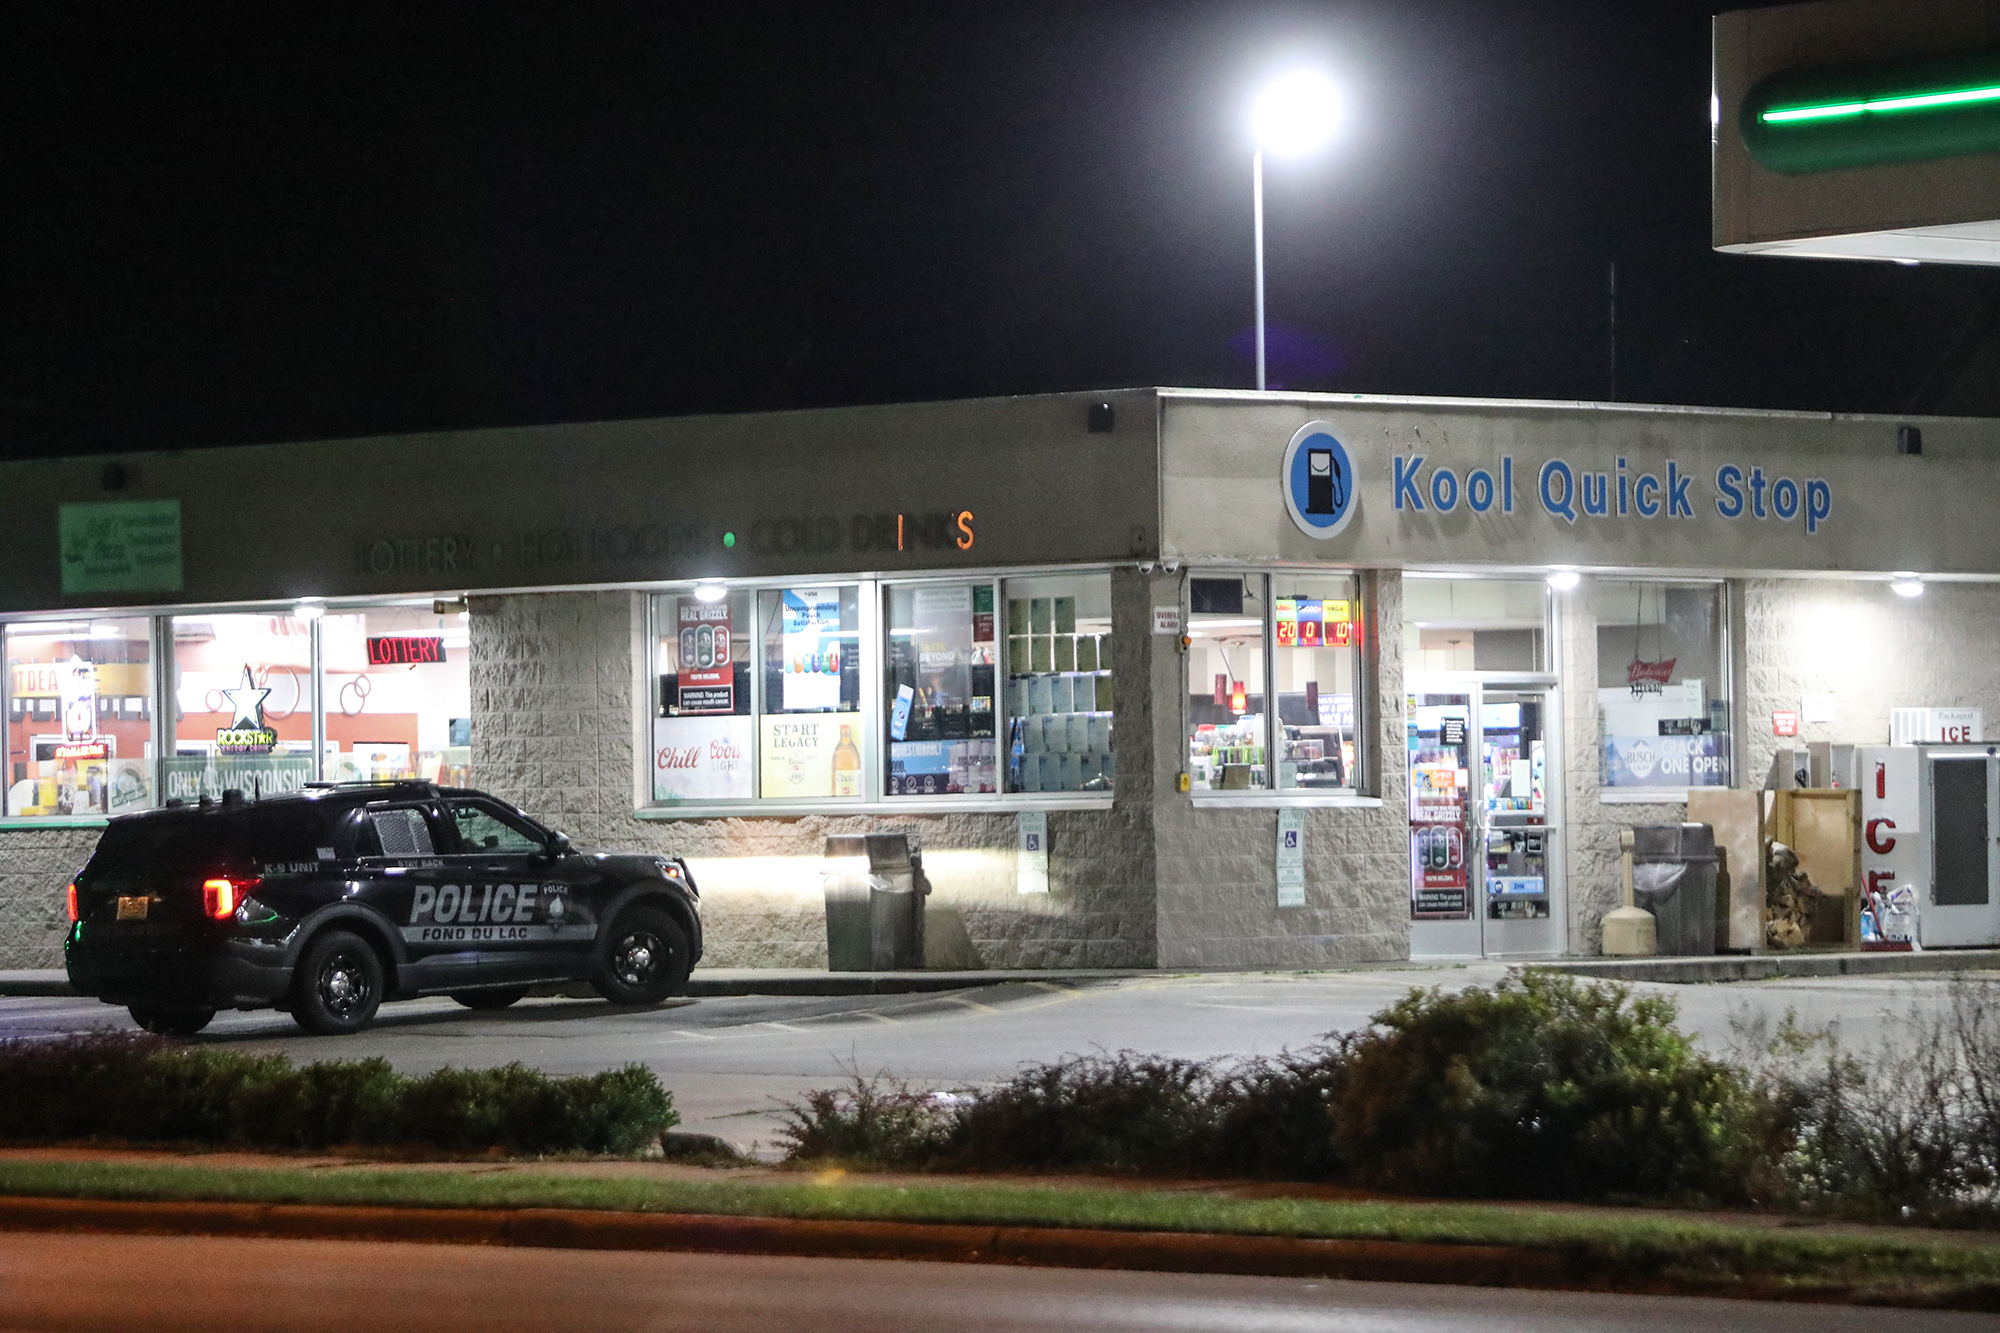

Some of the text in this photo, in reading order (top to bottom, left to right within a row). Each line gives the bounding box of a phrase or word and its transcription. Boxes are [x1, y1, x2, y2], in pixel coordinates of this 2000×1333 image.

[1391, 452, 1833, 535] Kool Quick Stop
[785, 604, 837, 612] Uncompromising
[681, 610, 698, 621] REAL
[1280, 622, 1295, 637] 20
[368, 636, 440, 664] LOTTERY
[921, 642, 946, 652] TASTE
[919, 651, 954, 662] BEYOND
[1938, 711, 1973, 720] Packaged
[217, 729, 273, 745] ROCKSTAR
[773, 723, 819, 737] START
[1941, 725, 1971, 742] ICE
[709, 738, 740, 760] Coors
[773, 736, 819, 749] LEGACY
[1661, 738, 1705, 755] CRACK
[657, 746, 702, 769] Chill
[1627, 751, 1656, 764] BUSCH
[712, 759, 739, 772] LIGHT
[1661, 756, 1729, 774] ONE OPEN
[168, 770, 204, 798] ONLY
[224, 768, 307, 798] WISCONSIN
[1416, 812, 1433, 821] REAL
[264, 861, 320, 874] K-9 UNIT
[398, 859, 445, 868] STAY BACK
[543, 884, 569, 895] POLICE
[409, 883, 538, 924] POLICE
[422, 926, 528, 940] FOND DU LAC
